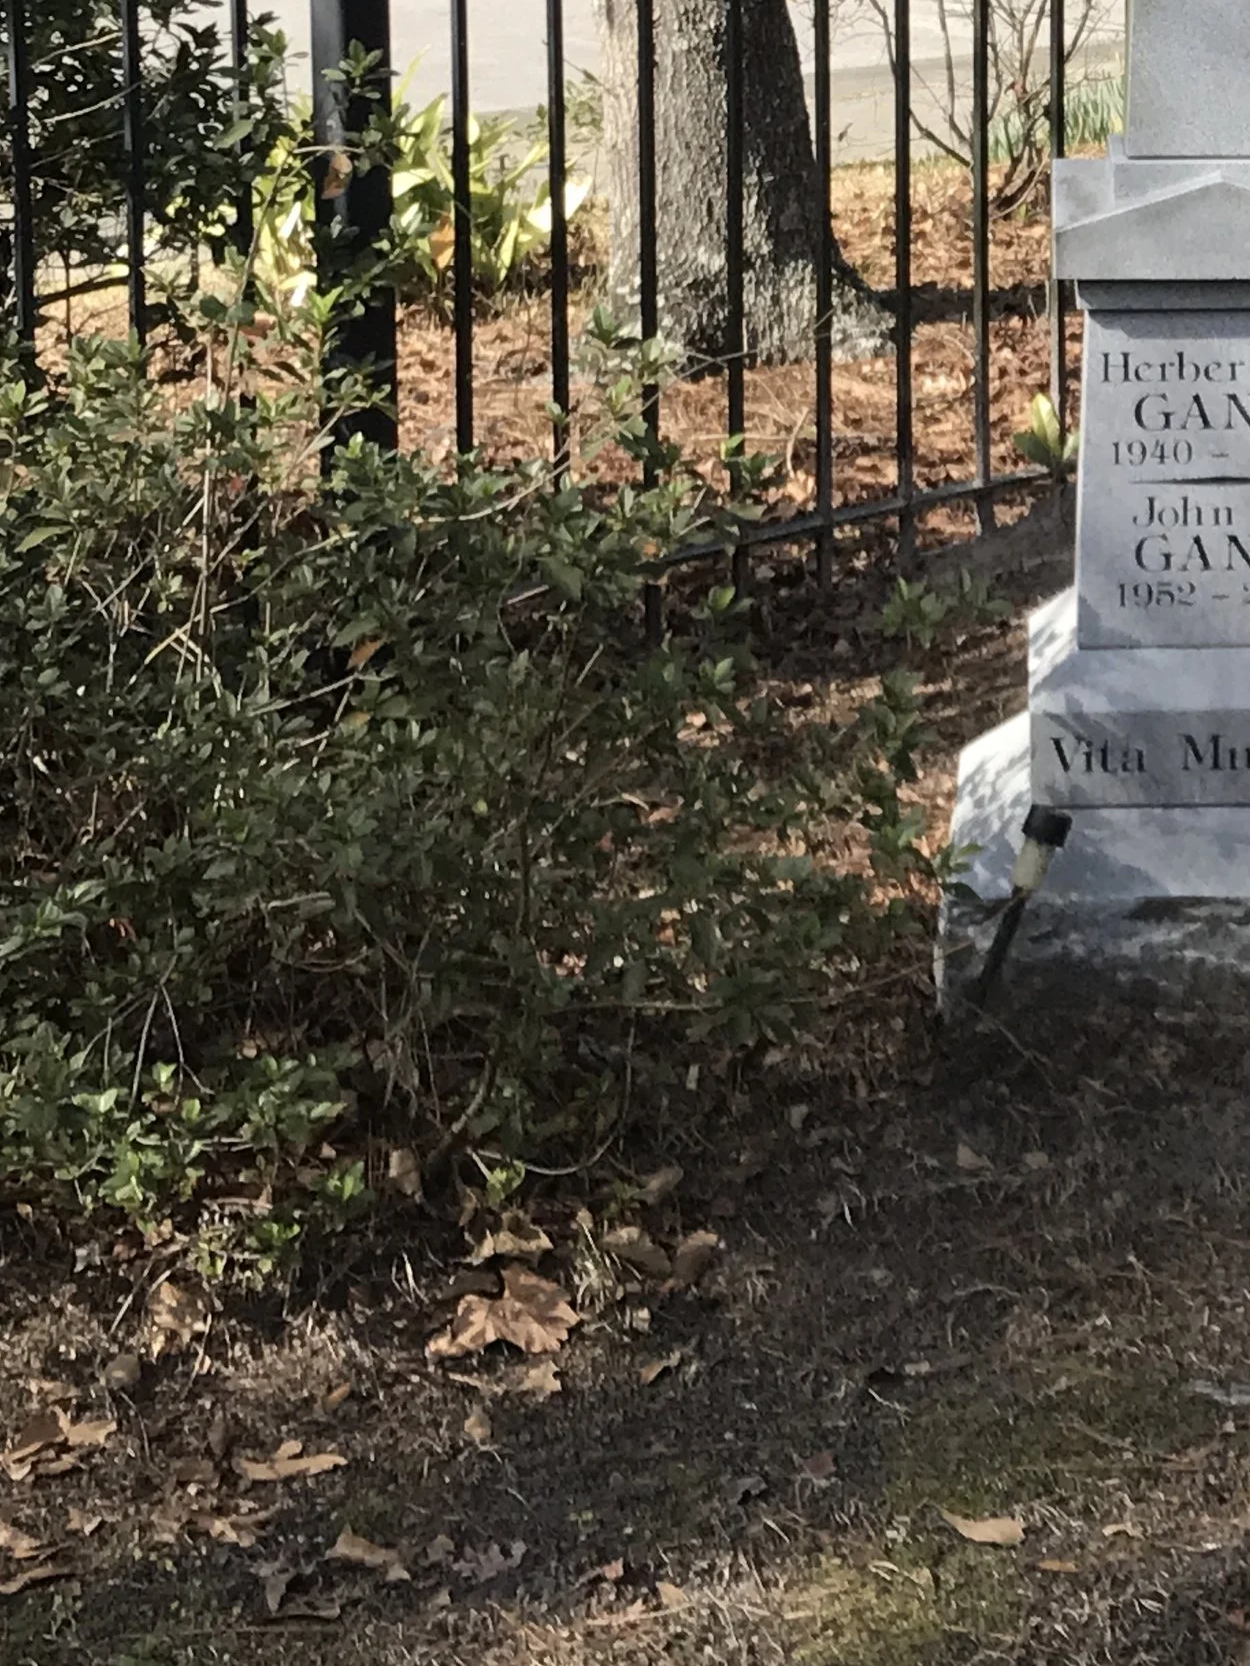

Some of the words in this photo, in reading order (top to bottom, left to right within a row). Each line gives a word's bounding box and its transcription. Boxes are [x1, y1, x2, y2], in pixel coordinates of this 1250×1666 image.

[1112, 438, 1193, 467] 1940
[1132, 495, 1234, 528] John
[1118, 581, 1196, 608] 1952
[1050, 736, 1147, 774] Vita
